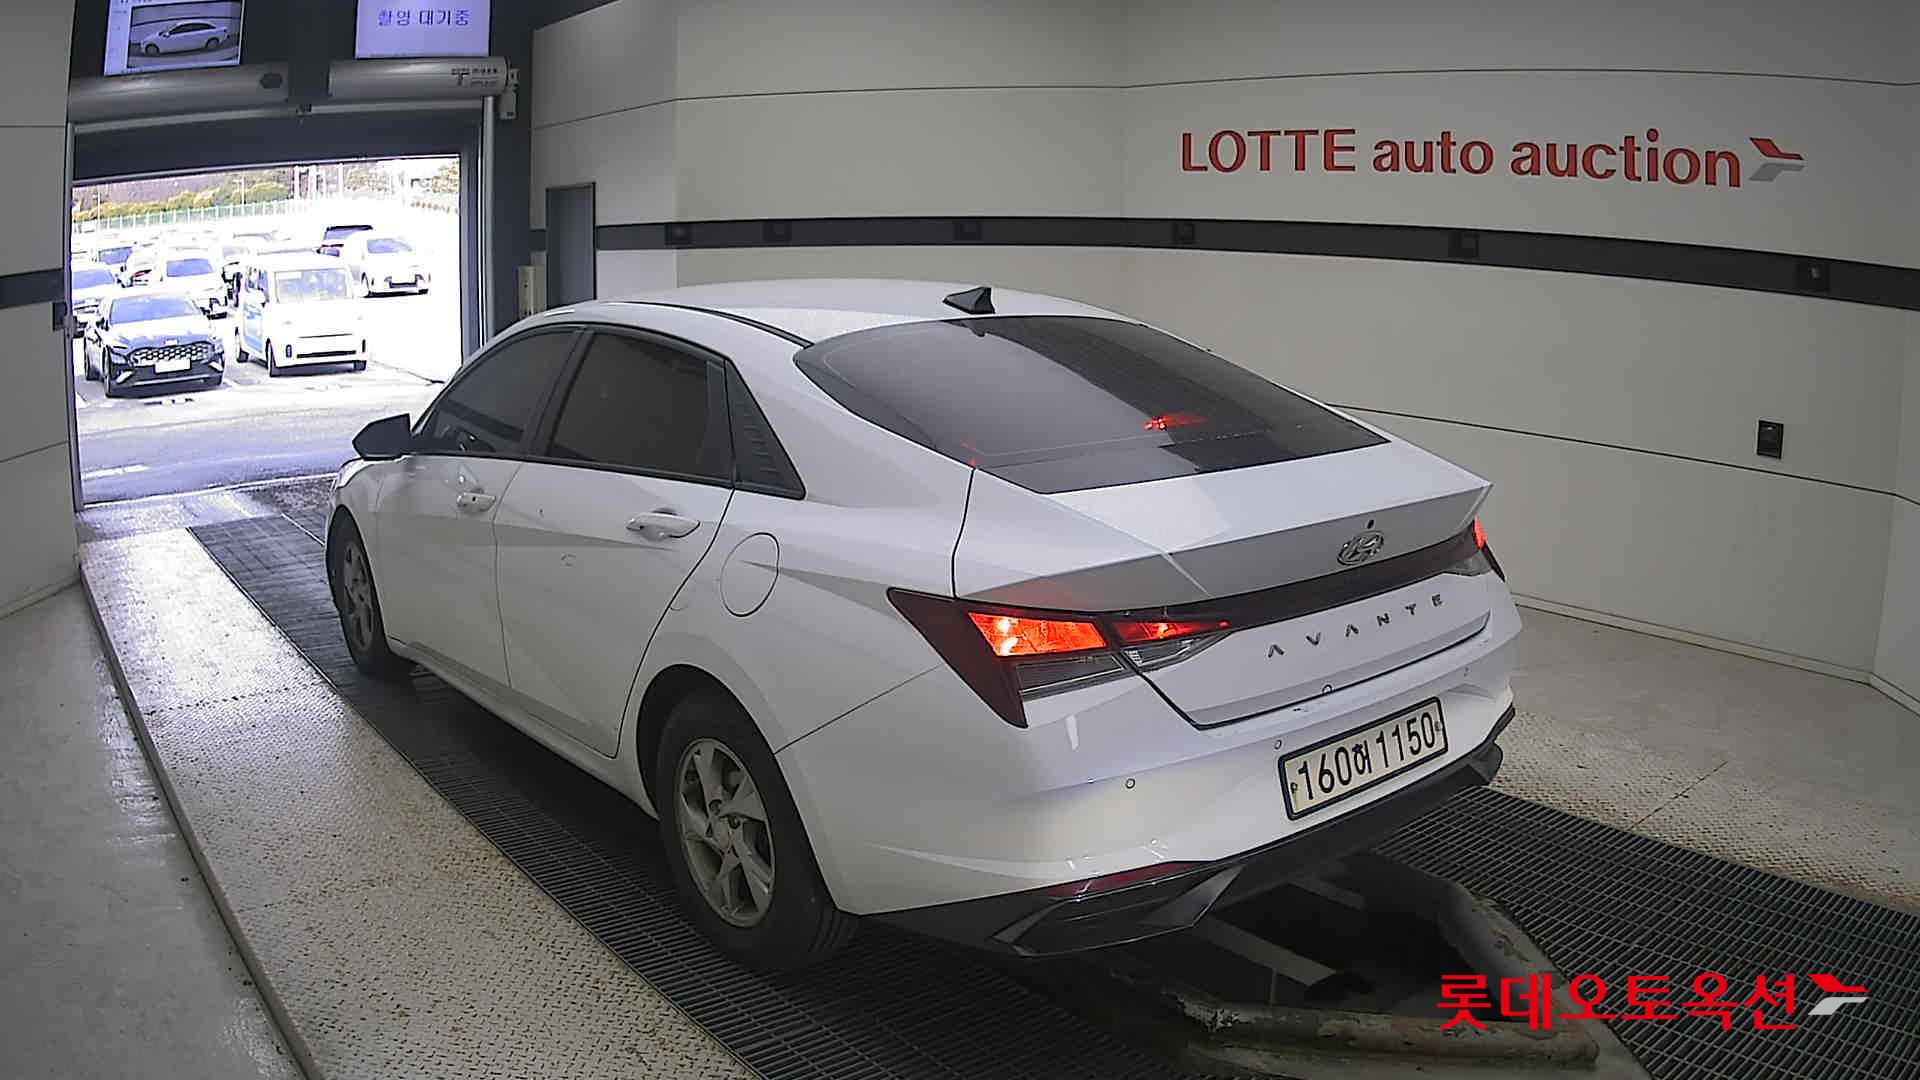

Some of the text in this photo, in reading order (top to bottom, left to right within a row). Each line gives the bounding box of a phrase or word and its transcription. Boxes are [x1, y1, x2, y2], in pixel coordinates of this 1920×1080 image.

[419, 9, 470, 26] 대기중
[1181, 128, 1741, 187] LOTTE auto auction
[1267, 593, 1443, 658] AVANTE
[1297, 712, 1436, 800] 160허 1150
